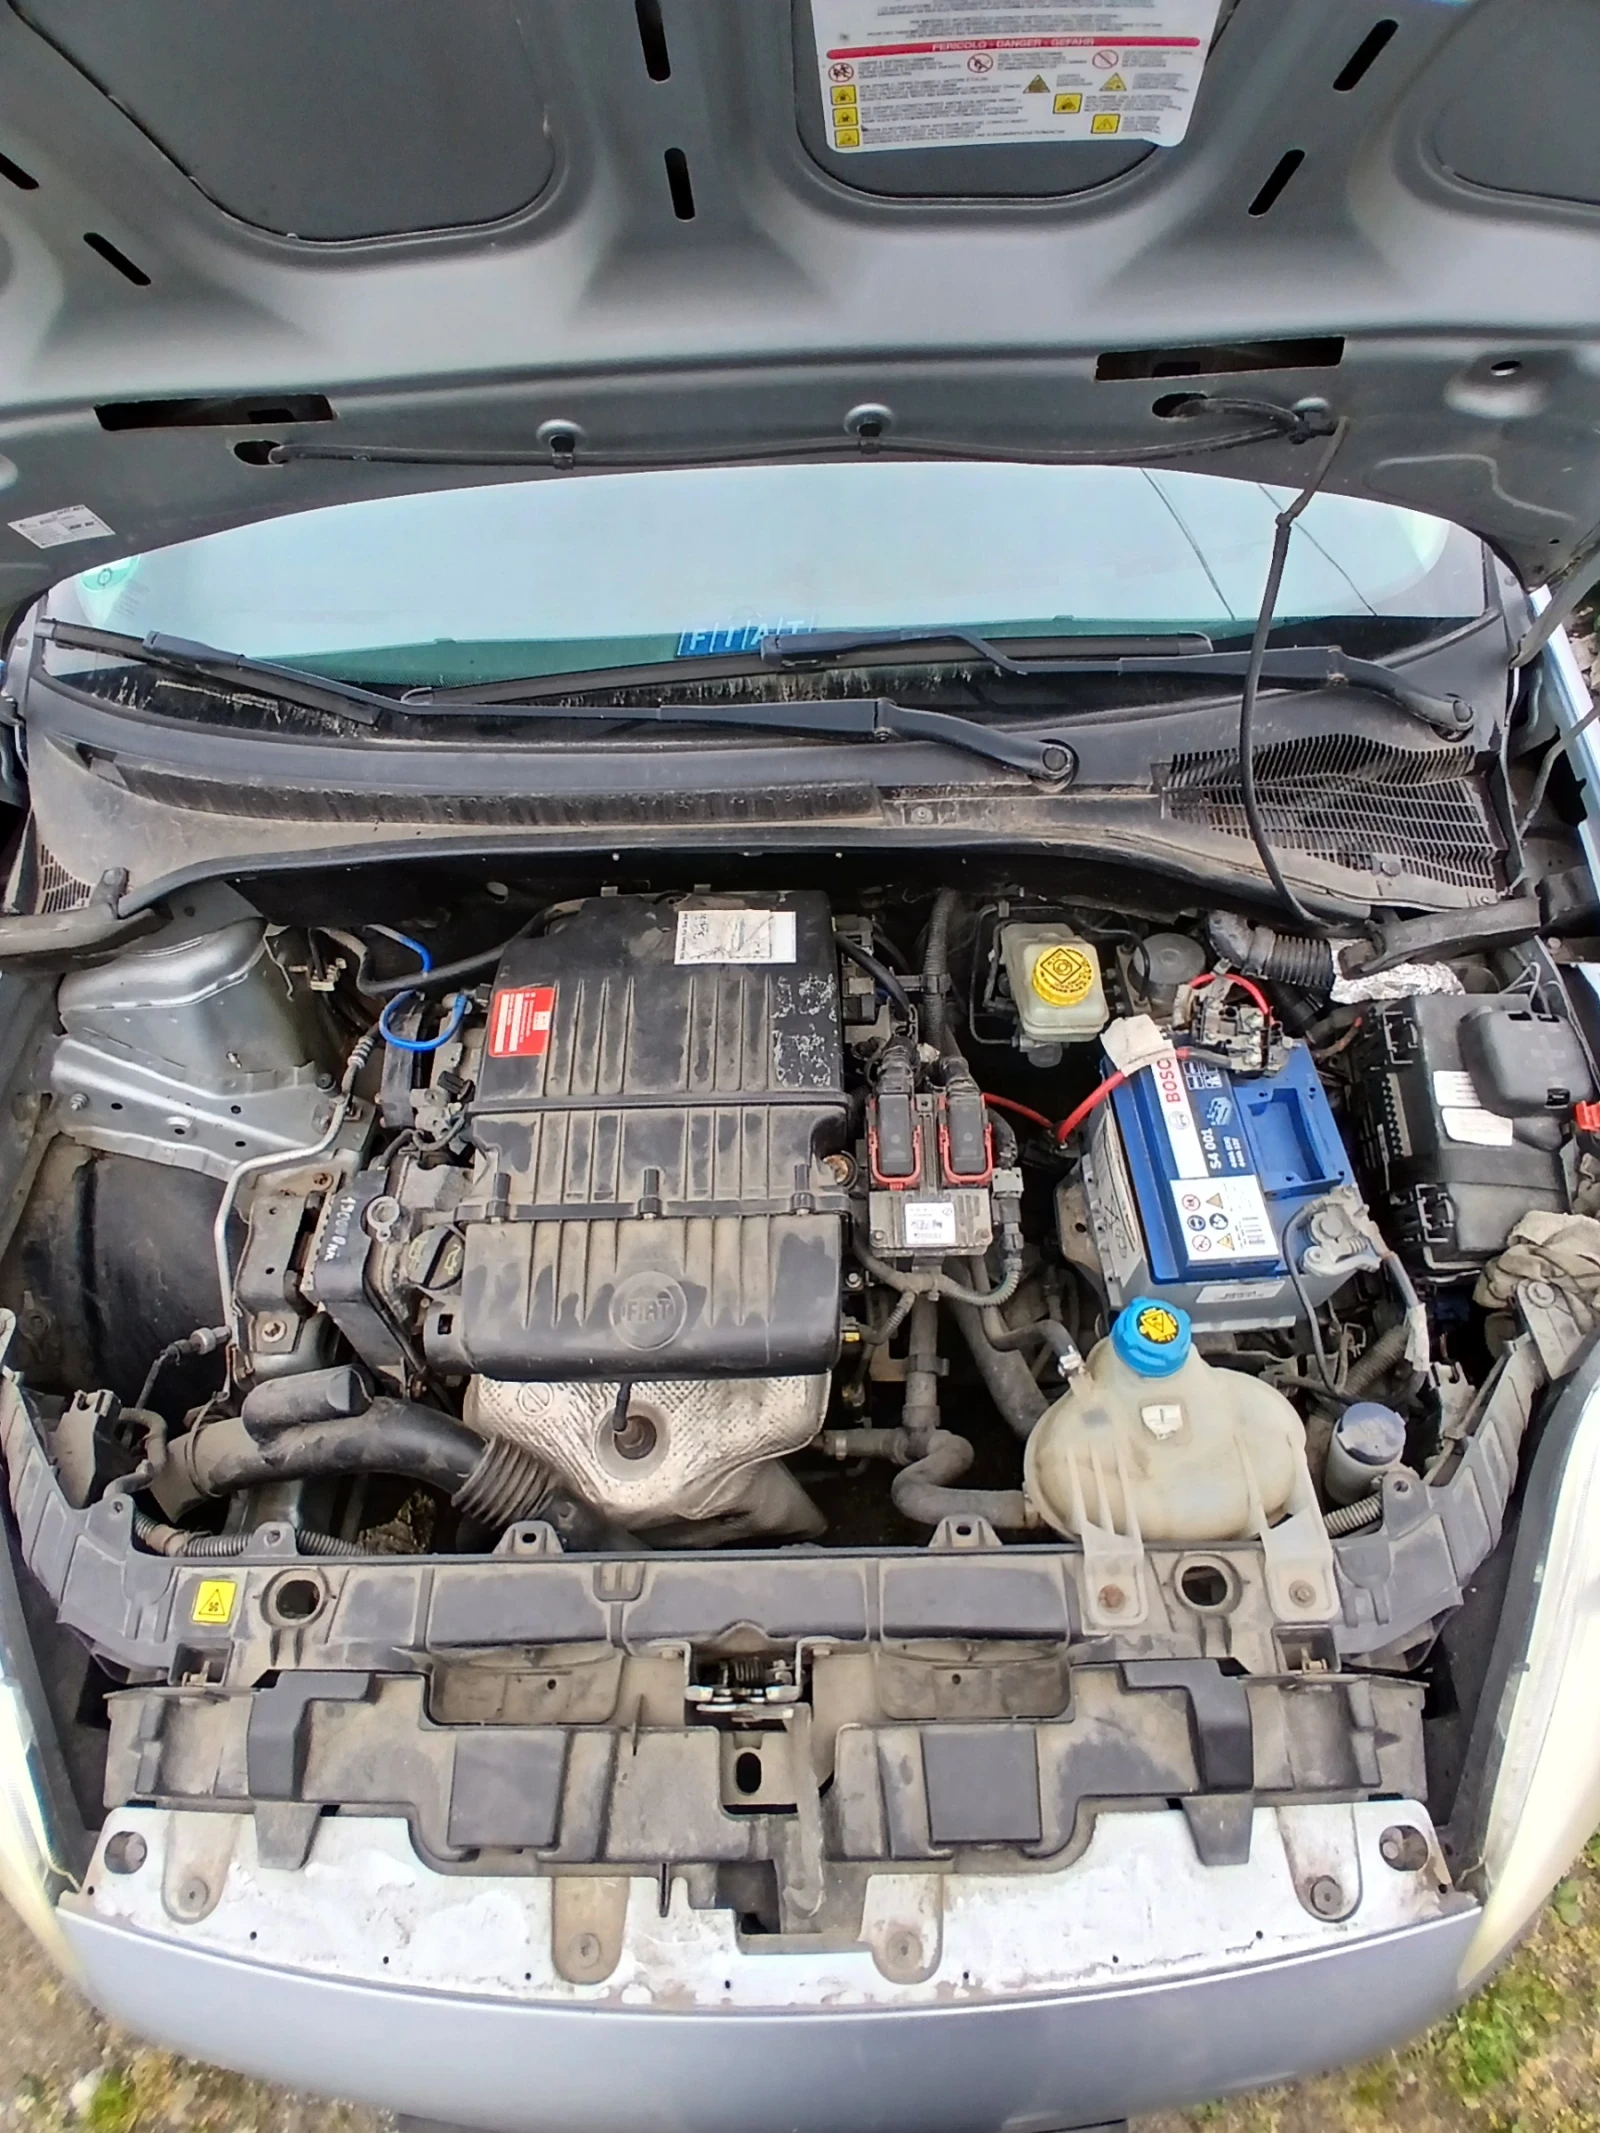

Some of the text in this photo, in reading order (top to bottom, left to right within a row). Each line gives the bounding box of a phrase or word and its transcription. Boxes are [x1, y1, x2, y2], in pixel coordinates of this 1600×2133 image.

[931, 42, 987, 51] PERICOLO
[996, 40, 1042, 48] DANGER
[1051, 37, 1095, 46] GEFAHR
[1156, 1058, 1181, 1103] BOSC
[1201, 1127, 1222, 1169] S4 001
[627, 1300, 670, 1321] FIAT
